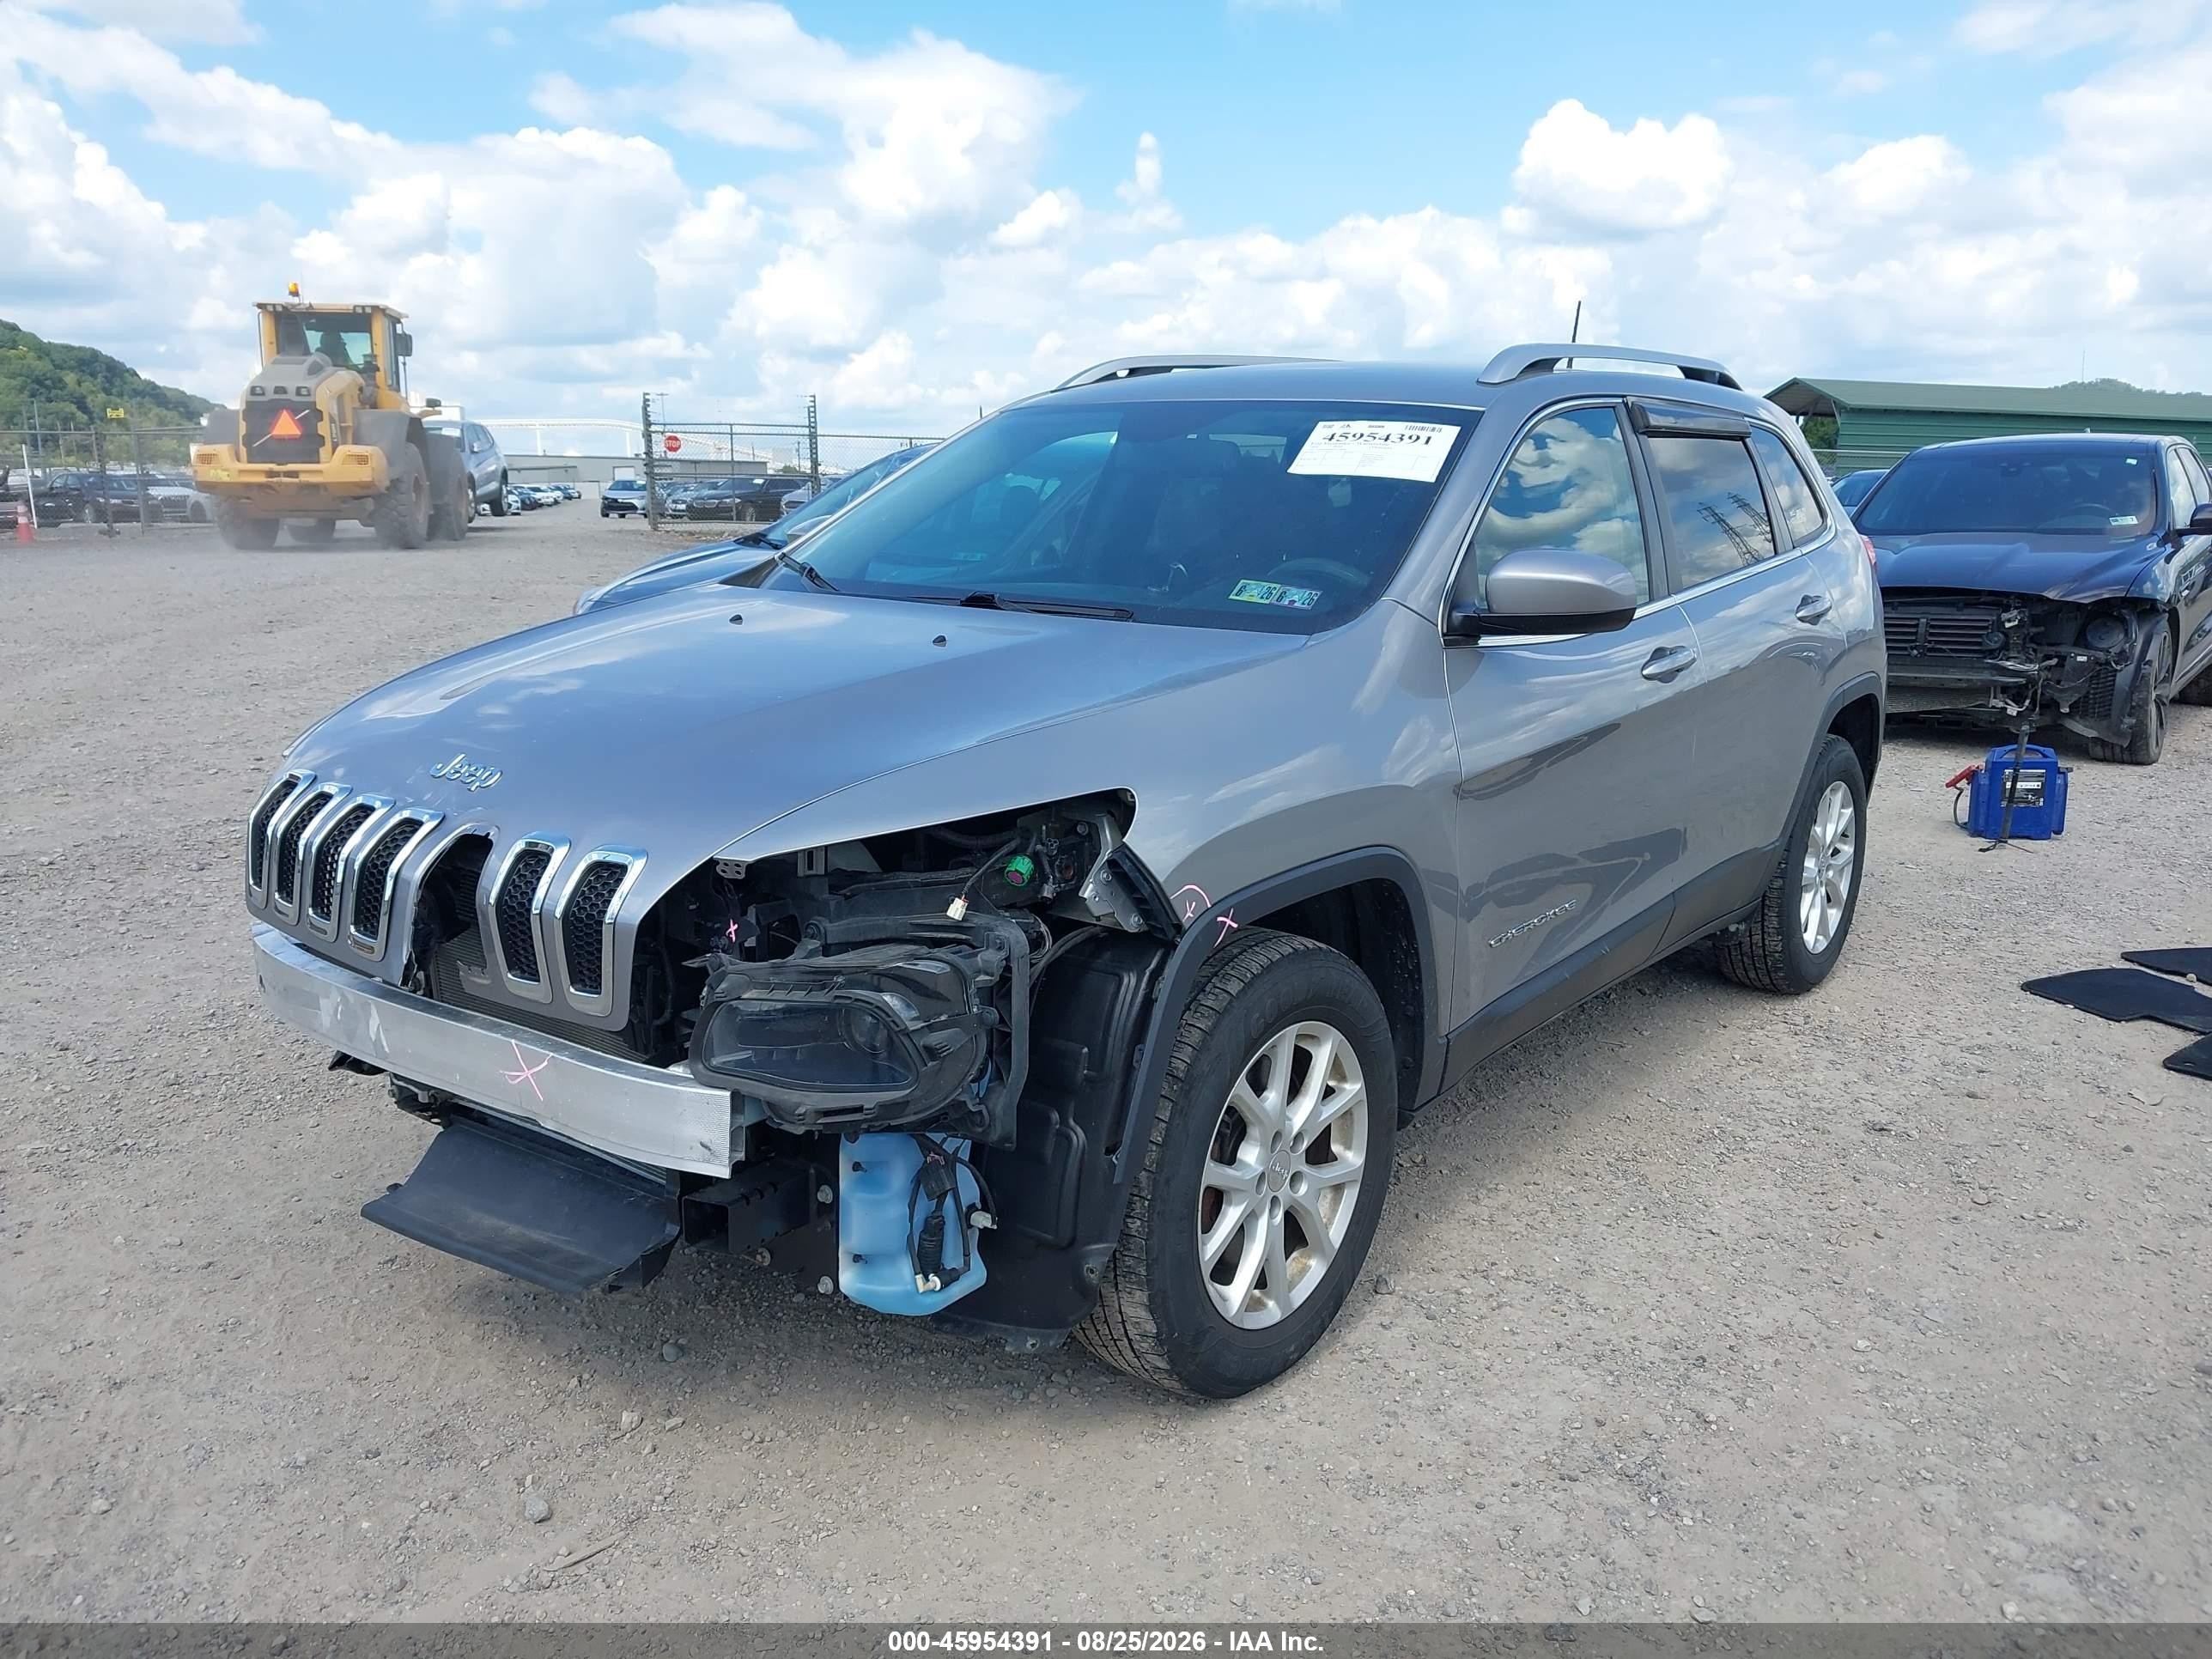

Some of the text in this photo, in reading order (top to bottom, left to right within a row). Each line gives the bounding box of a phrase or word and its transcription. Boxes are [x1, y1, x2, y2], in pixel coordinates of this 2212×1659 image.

[1322, 431, 1433, 446] 45954391
[1236, 585, 1277, 600] 6 26
[1276, 591, 1318, 606] 6 26
[429, 753, 503, 792] Jeep
[1489, 899, 1577, 948] CHEROKEE
